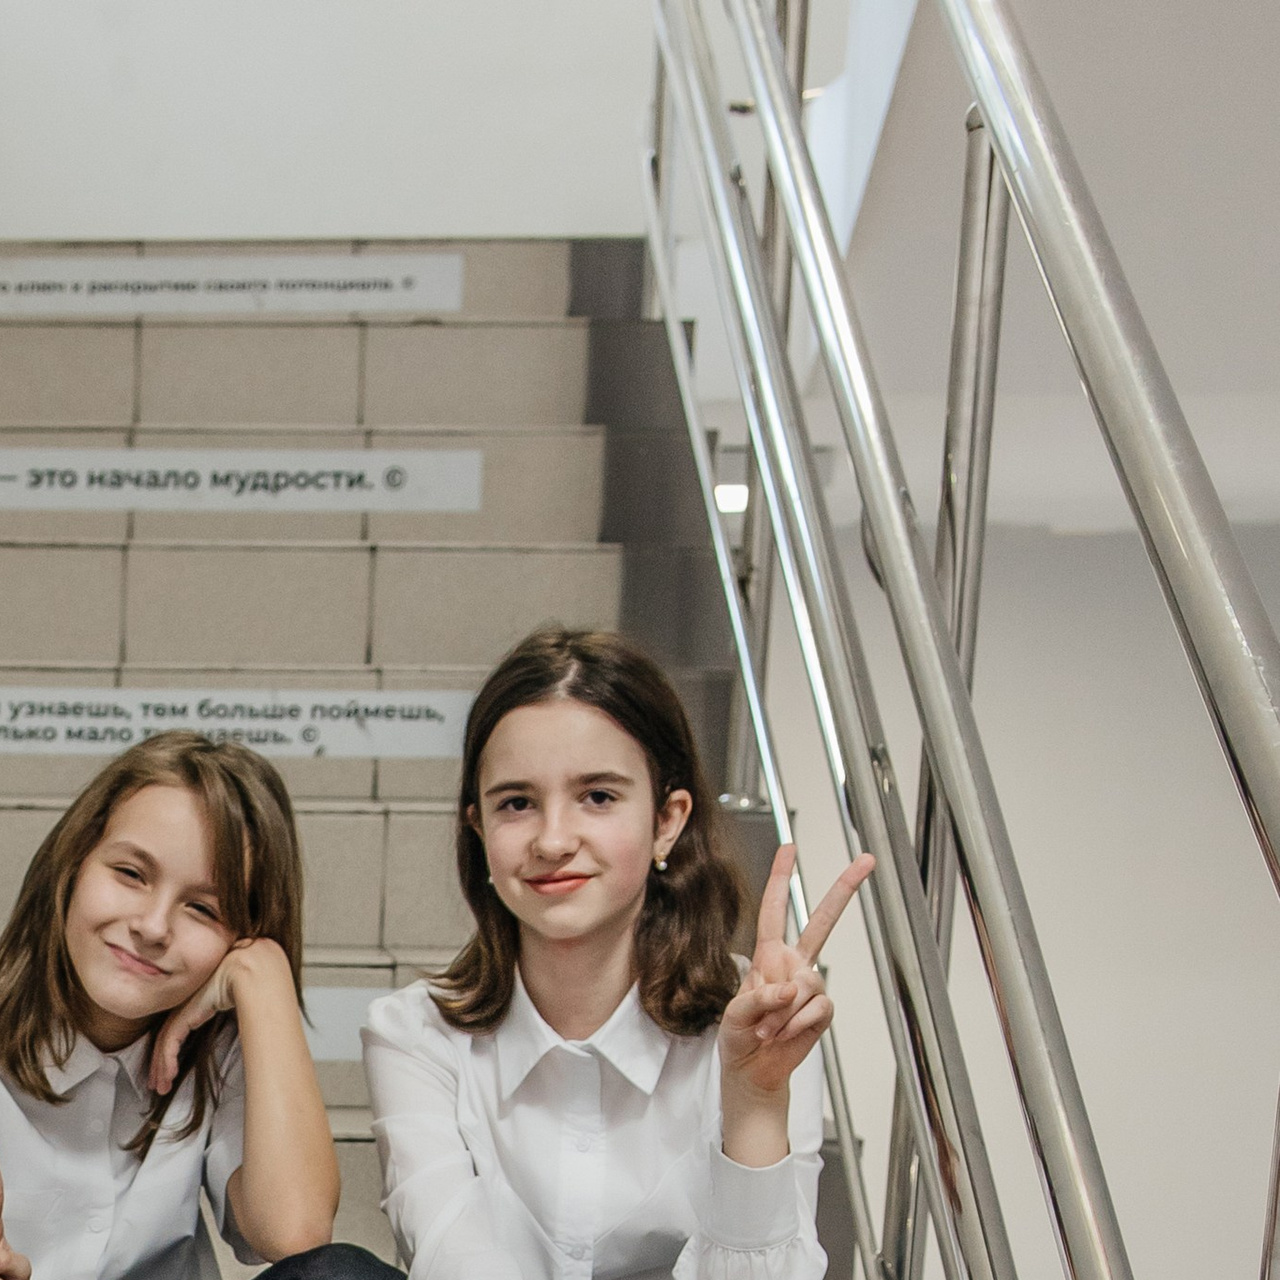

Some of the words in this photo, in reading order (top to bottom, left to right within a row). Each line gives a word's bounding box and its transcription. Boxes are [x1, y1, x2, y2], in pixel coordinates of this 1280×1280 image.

[29, 469, 77, 488] это
[86, 469, 200, 489] начало
[211, 469, 373, 495] мудрости.
[9, 699, 132, 721] узнаешь,
[140, 701, 187, 718] тем
[197, 699, 301, 720] больше
[66, 726, 133, 742] мало
